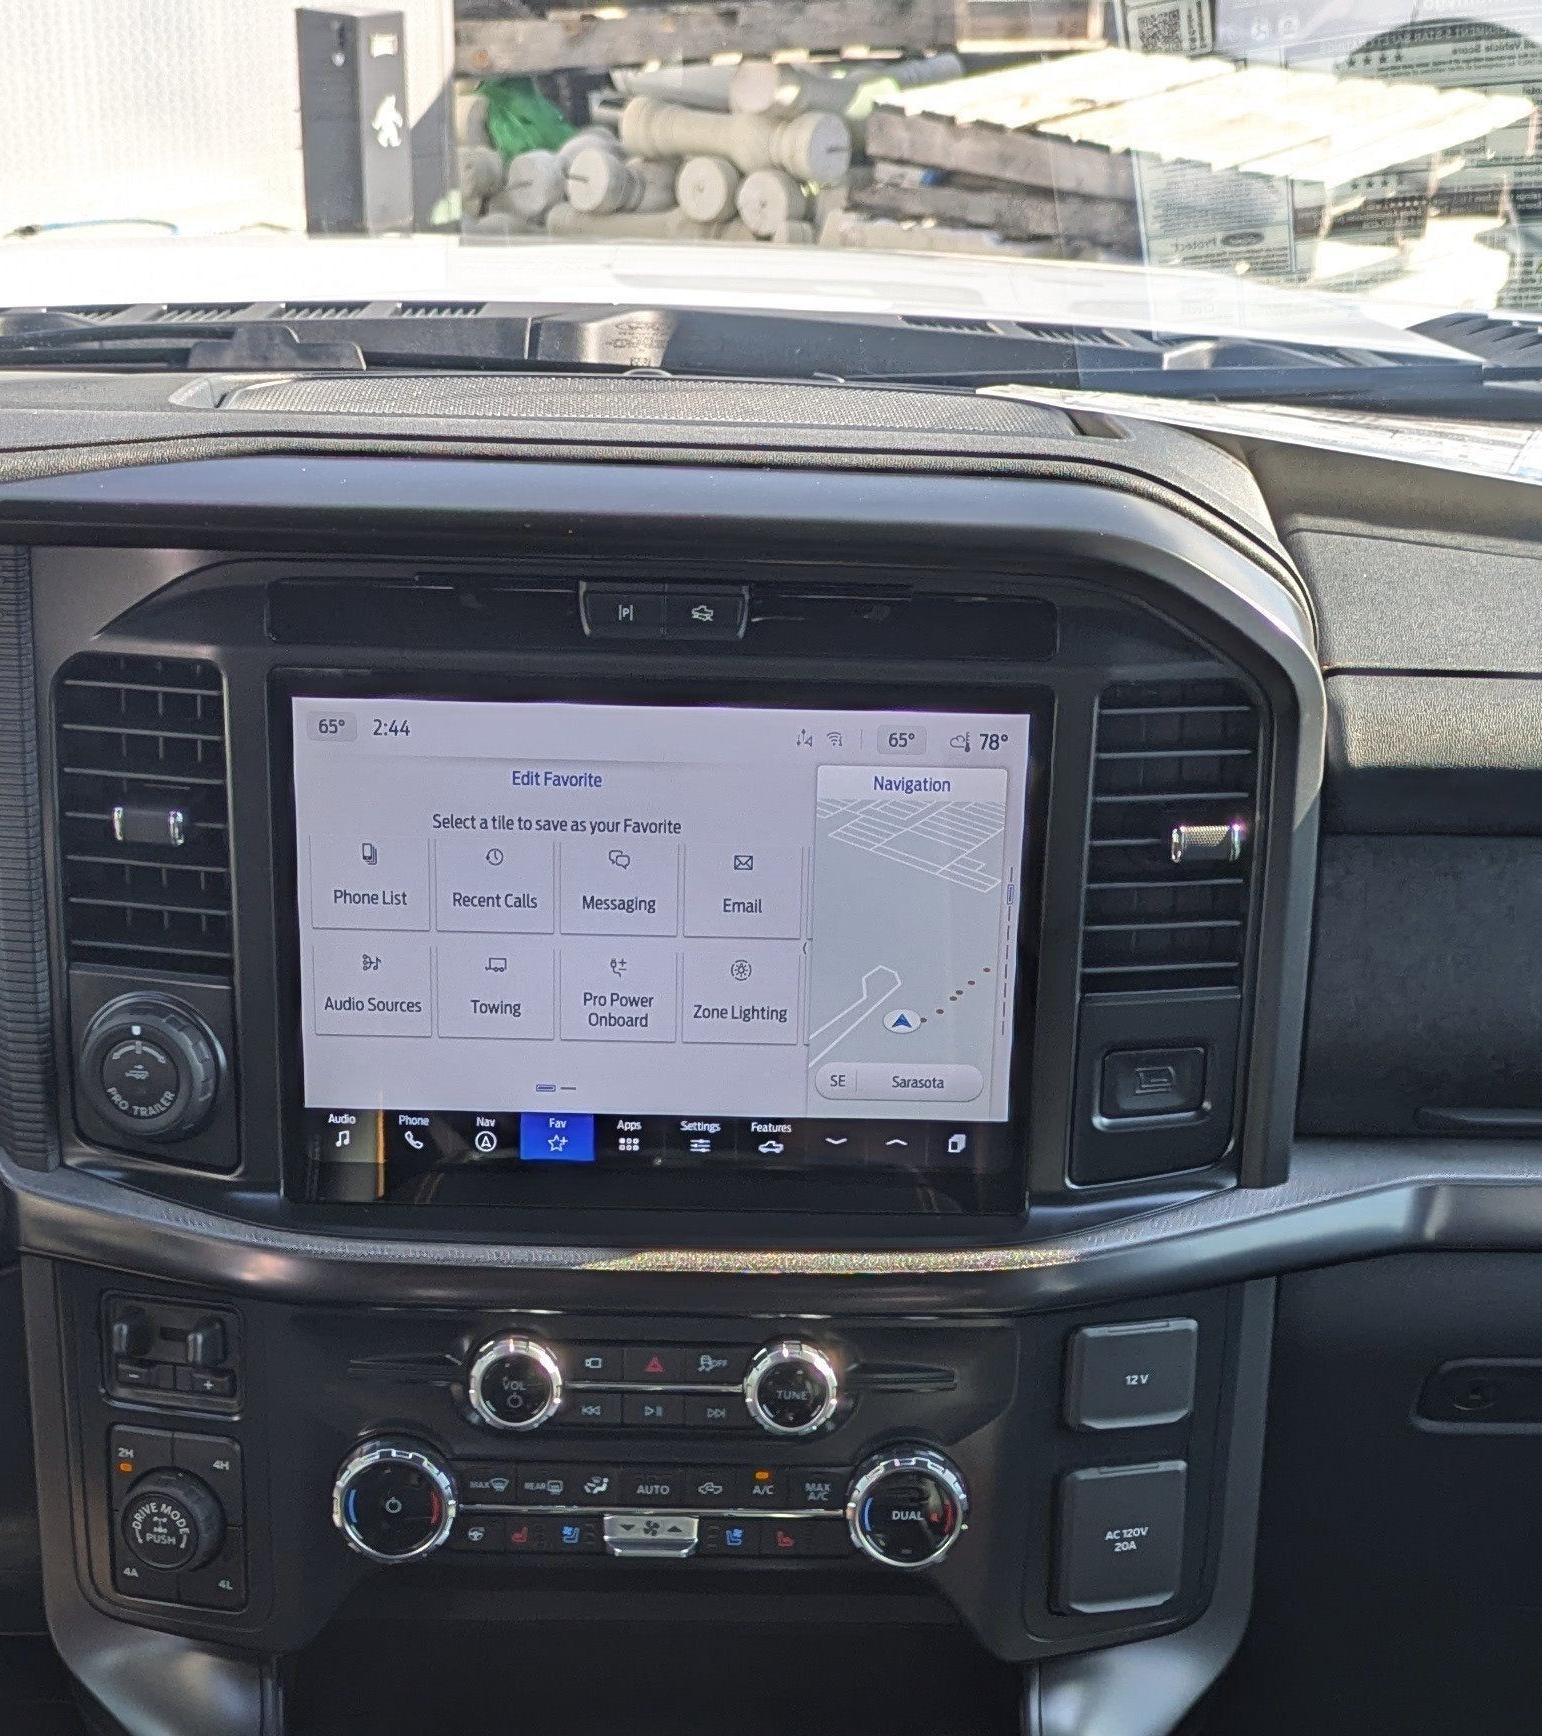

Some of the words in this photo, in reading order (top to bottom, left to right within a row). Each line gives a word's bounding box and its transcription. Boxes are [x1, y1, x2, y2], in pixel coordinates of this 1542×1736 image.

[318, 718, 346, 735] 65°
[372, 718, 411, 736] 2:44
[888, 732, 916, 748] 65°
[979, 733, 1009, 751] 78°
[511, 770, 541, 787] Edit
[543, 771, 604, 789] Favorite
[873, 775, 952, 794] Navigation
[432, 813, 476, 831] Select
[479, 818, 488, 830] a
[491, 814, 515, 831] tile
[517, 817, 533, 832] to
[535, 820, 568, 833] save
[570, 821, 586, 833] as
[589, 821, 621, 836] your
[623, 818, 682, 835] Favorite
[332, 889, 380, 906] Phone
[382, 890, 408, 906] List
[452, 892, 501, 908] Recent
[504, 893, 538, 909] Calls
[582, 895, 656, 914] Messaging
[722, 898, 763, 914] Email
[324, 996, 364, 1012] Audio
[367, 997, 422, 1013] Sources
[583, 992, 607, 1007] Pro
[609, 992, 654, 1008] Power
[470, 999, 522, 1018] Towing
[693, 1004, 729, 1020] Zone
[732, 1005, 788, 1023] Lighting
[588, 1012, 648, 1028] Onboard
[830, 1074, 846, 1088] SE
[891, 1075, 944, 1090] Sarasota
[106, 1086, 129, 1110] PRO
[132, 1090, 176, 1117] TRAILER
[328, 1113, 357, 1126] Audio
[398, 1114, 430, 1127] Phone
[475, 1116, 496, 1128] Nav
[548, 1117, 568, 1129] Fav
[616, 1119, 642, 1132] Apps
[680, 1120, 721, 1134] Settings
[750, 1121, 792, 1134] Features
[503, 1379, 527, 1391] VOL
[1125, 1374, 1138, 1386] 12
[1139, 1373, 1150, 1385] V
[776, 1389, 809, 1401] TUNE
[117, 1447, 134, 1459] 2H
[212, 1459, 230, 1471] 4H
[636, 1484, 670, 1495] AUTO
[752, 1485, 774, 1495] A/C
[805, 1483, 831, 1492] MAX
[809, 1491, 829, 1501] A/C
[131, 1502, 158, 1531] DRIVE
[160, 1502, 190, 1536] MODE
[891, 1510, 924, 1521] DUAL
[145, 1533, 177, 1546] PUSH
[1105, 1530, 1121, 1541] AC
[1122, 1526, 1149, 1539] 120V
[1114, 1540, 1138, 1552] 20A
[122, 1567, 139, 1578] 4A
